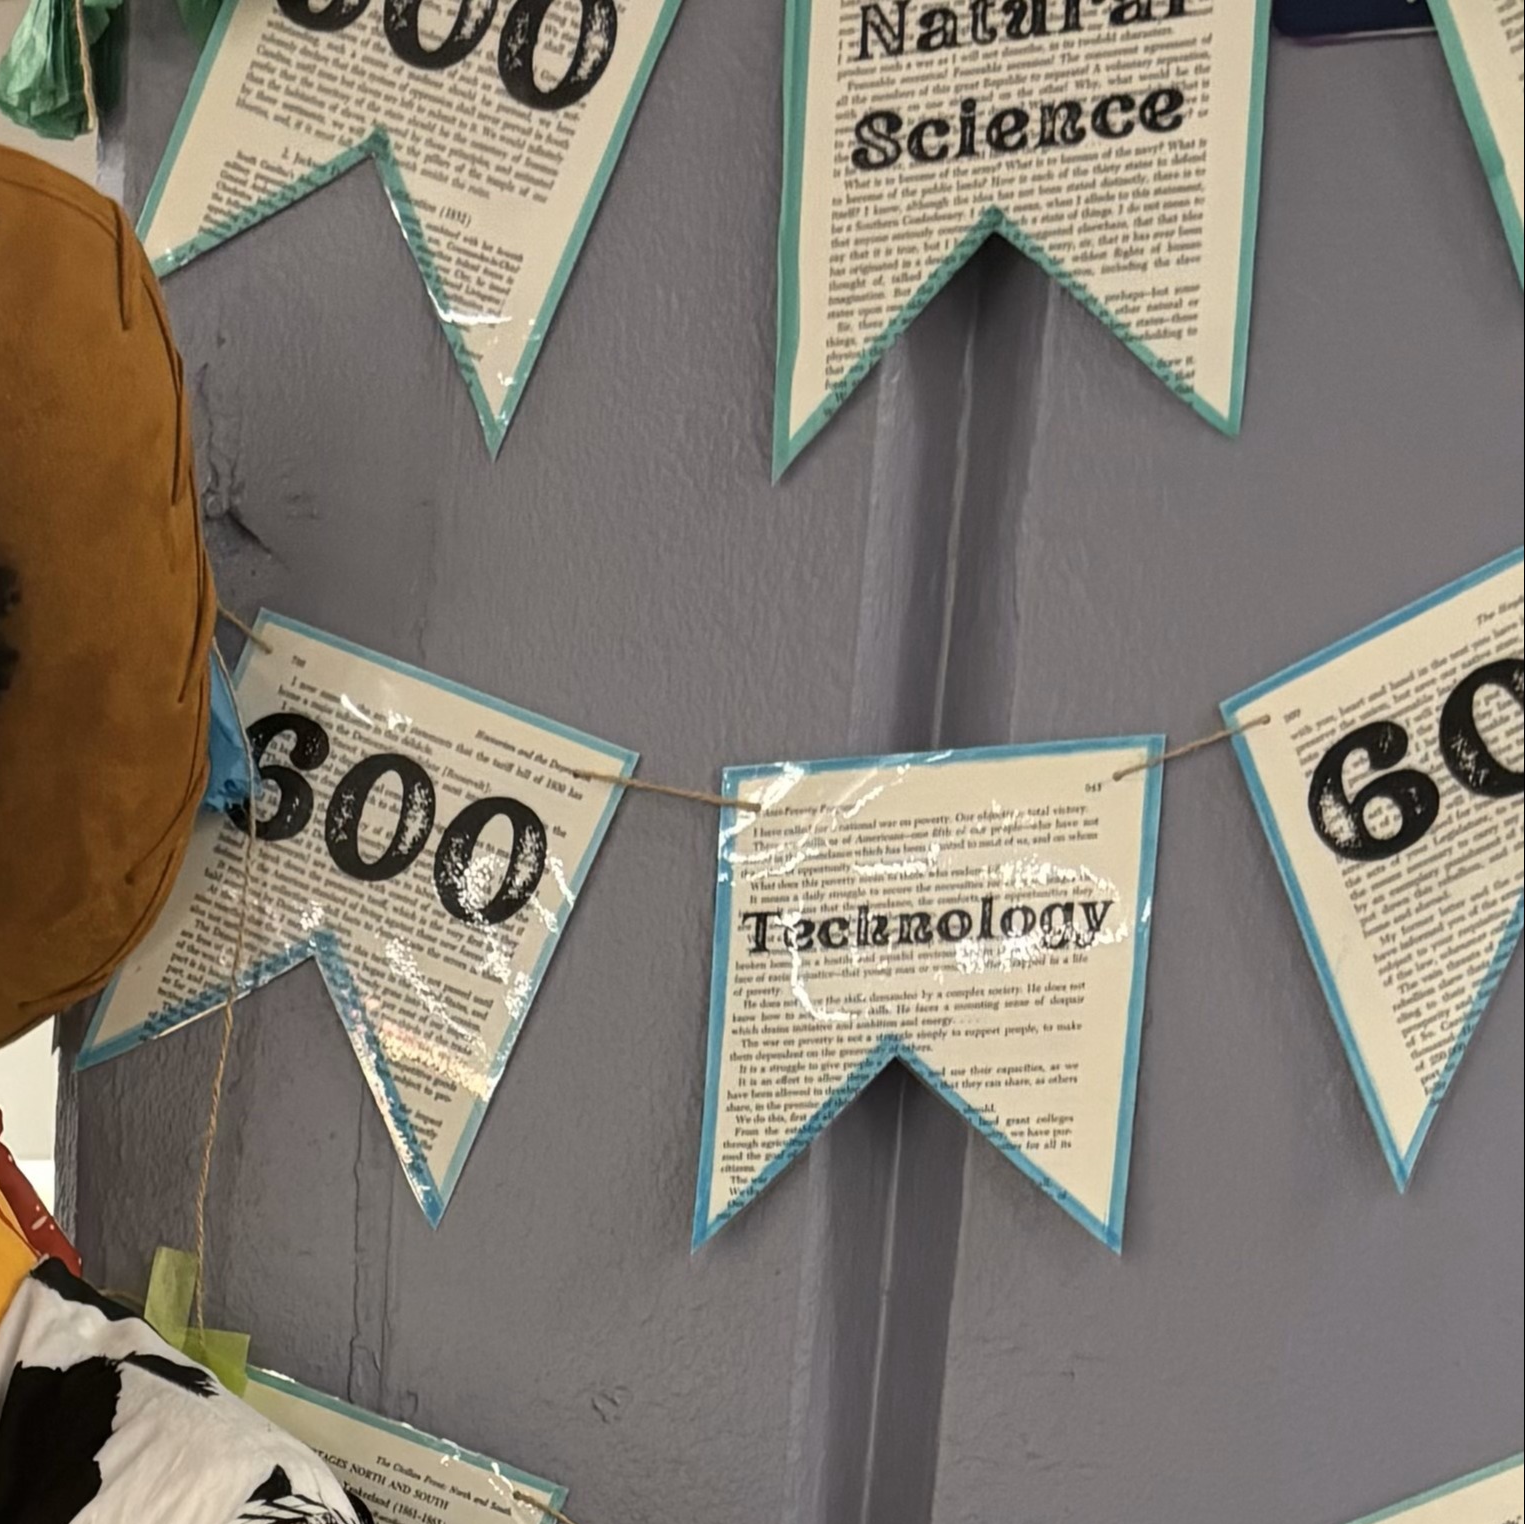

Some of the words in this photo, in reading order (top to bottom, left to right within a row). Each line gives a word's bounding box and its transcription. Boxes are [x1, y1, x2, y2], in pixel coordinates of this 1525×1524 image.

[852, 85, 1187, 170] Science
[226, 711, 548, 926] 600
[742, 897, 1115, 954] Technology
